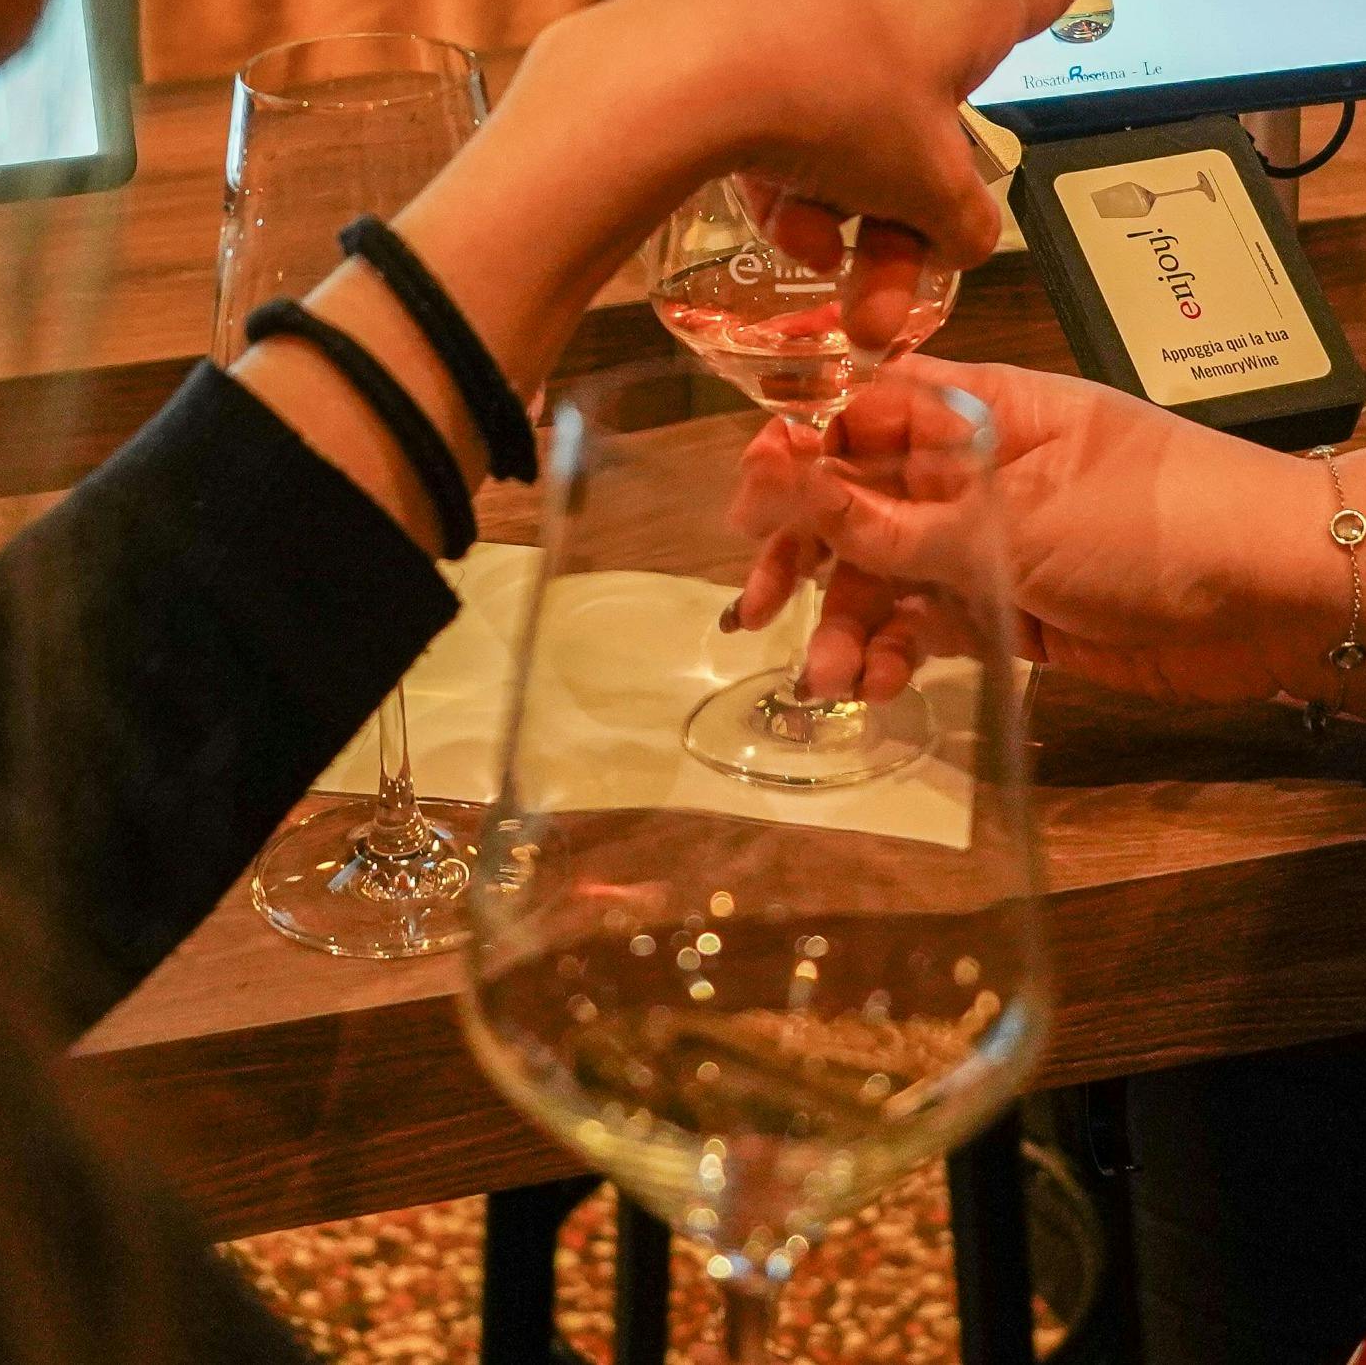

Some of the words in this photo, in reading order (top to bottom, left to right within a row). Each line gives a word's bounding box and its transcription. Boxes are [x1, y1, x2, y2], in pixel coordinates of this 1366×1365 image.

[1022, 74, 1071, 90] Rosato
[1143, 61, 1163, 76] Le
[1161, 340, 1224, 364] Appoggia
[1225, 333, 1248, 351] qui
[1248, 332, 1265, 346] la
[1265, 329, 1290, 343] tua
[1190, 353, 1280, 381] MemoryWine
